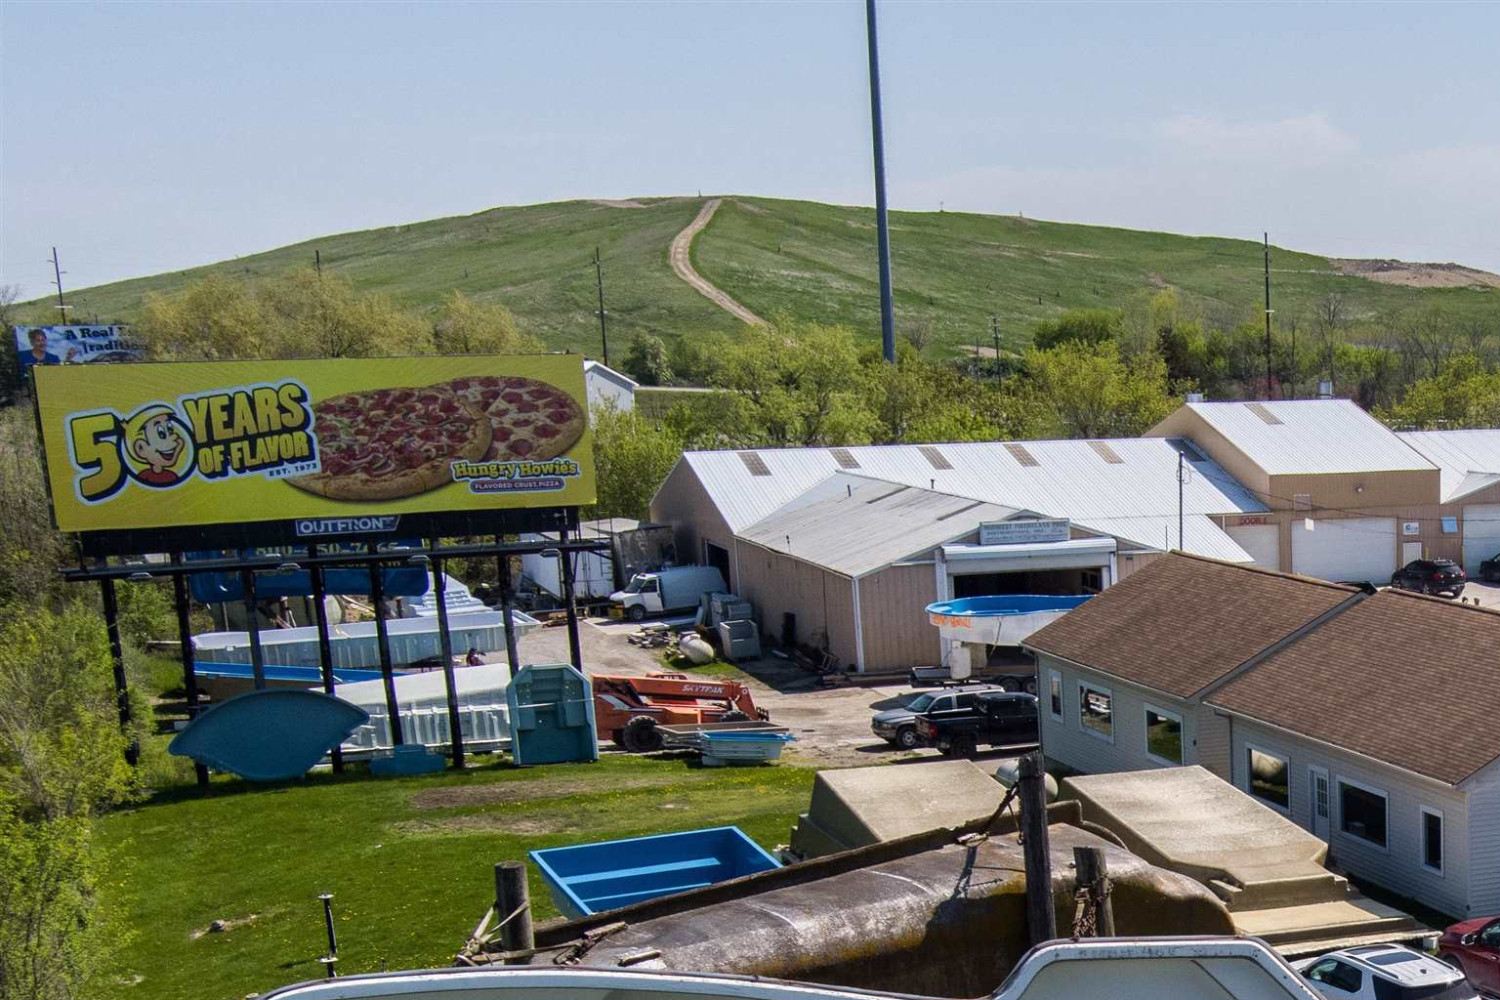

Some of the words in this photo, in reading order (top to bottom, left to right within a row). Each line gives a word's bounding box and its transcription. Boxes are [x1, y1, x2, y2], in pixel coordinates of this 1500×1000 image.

[79, 327, 114, 338] Real
[183, 383, 310, 444] YEARS
[199, 447, 227, 475] OF
[229, 432, 312, 471] FLAVOR
[268, 469, 291, 477] EST.
[295, 463, 318, 473] 1973
[453, 461, 517, 479] Hungry
[519, 459, 579, 475] Howie's
